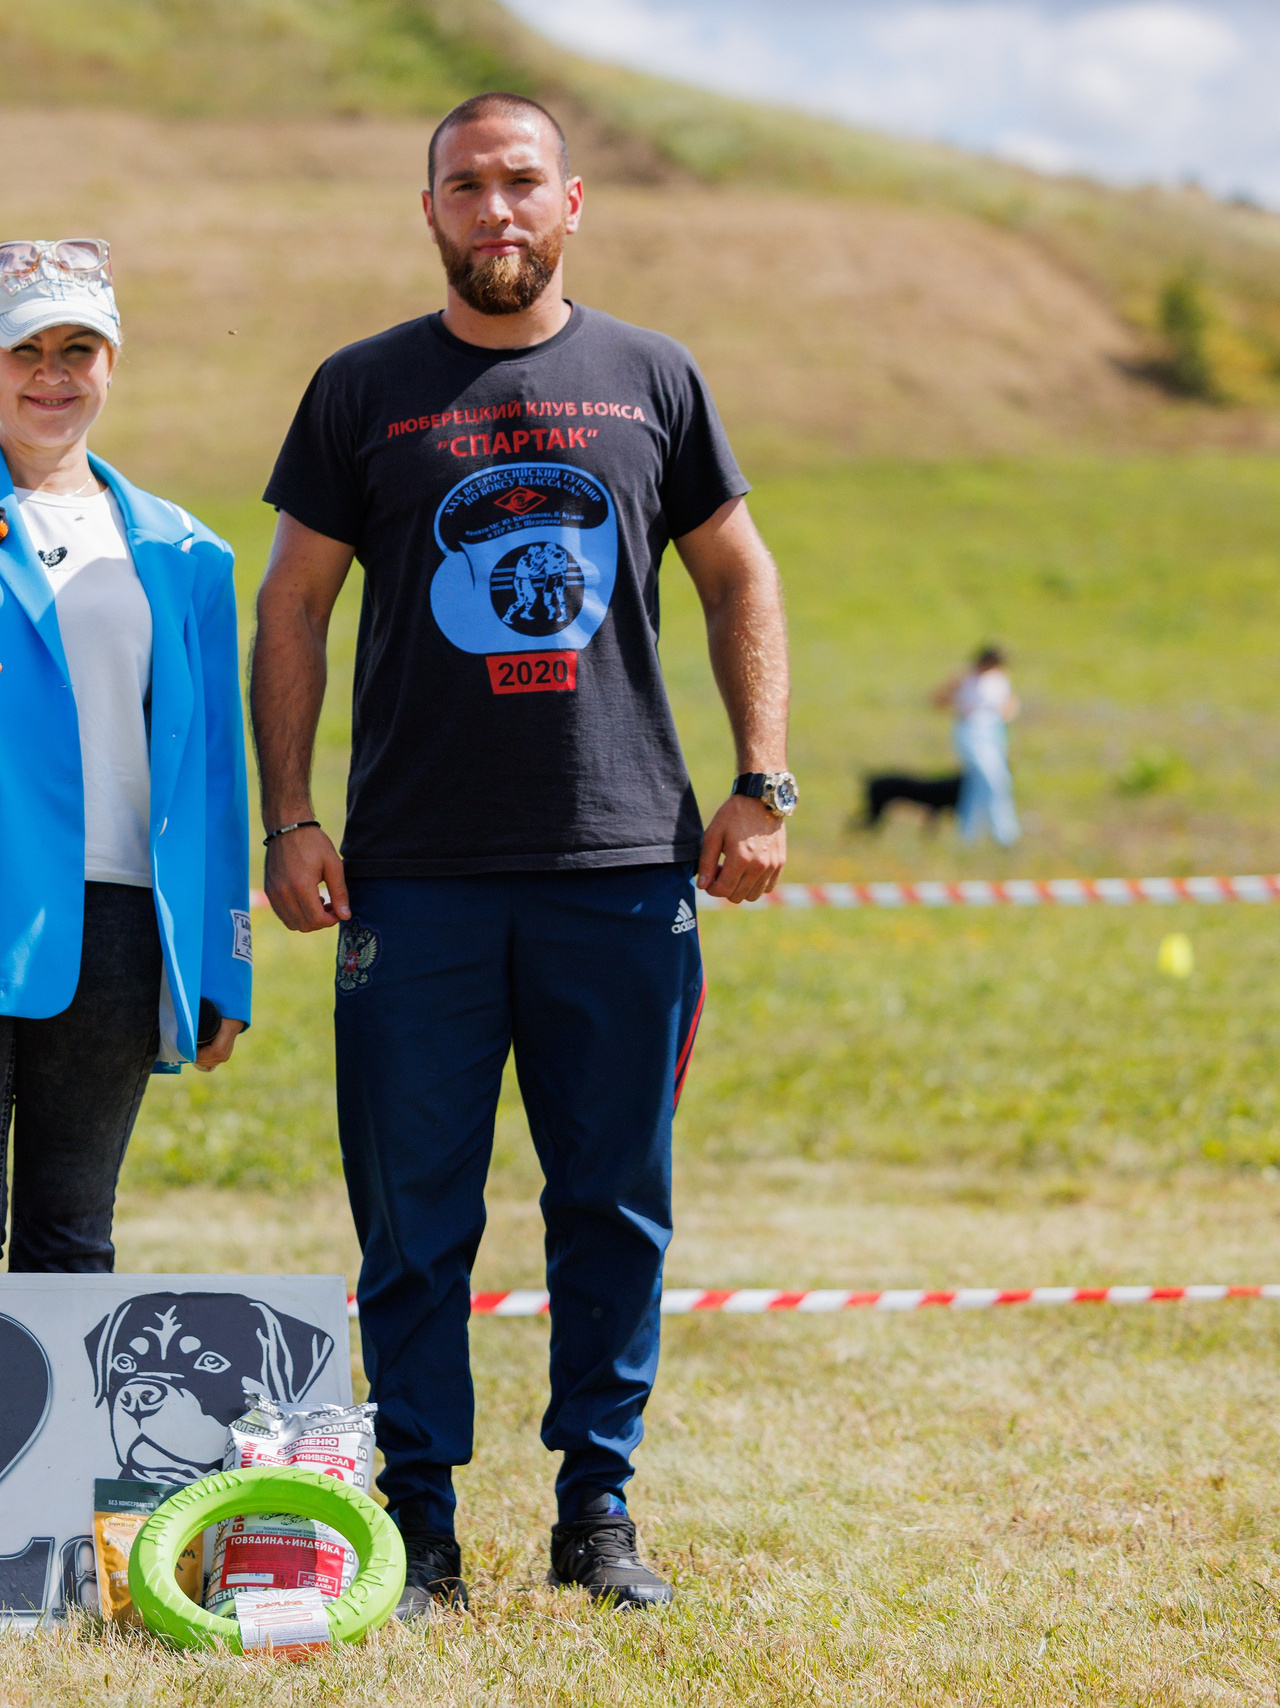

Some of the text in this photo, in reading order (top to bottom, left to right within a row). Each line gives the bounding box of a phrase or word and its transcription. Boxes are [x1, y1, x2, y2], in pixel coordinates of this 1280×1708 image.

[387, 400, 646, 438] ЛЮБЕРЕЦКИЙ КЛУБ БОКСА
[463, 492, 480, 506] ПО
[480, 479, 515, 496] БОКСУ
[518, 477, 561, 489] КЛАССА
[563, 472, 601, 502] ТУРНИР
[498, 659, 568, 687] 2020
[278, 1438, 338, 1455] ЗООМЕНЮ
[295, 1454, 349, 1468] УНИВЕРСАЛ
[231, 1537, 340, 1556] ГОВЯДИНА+ИНДЕЙКА
